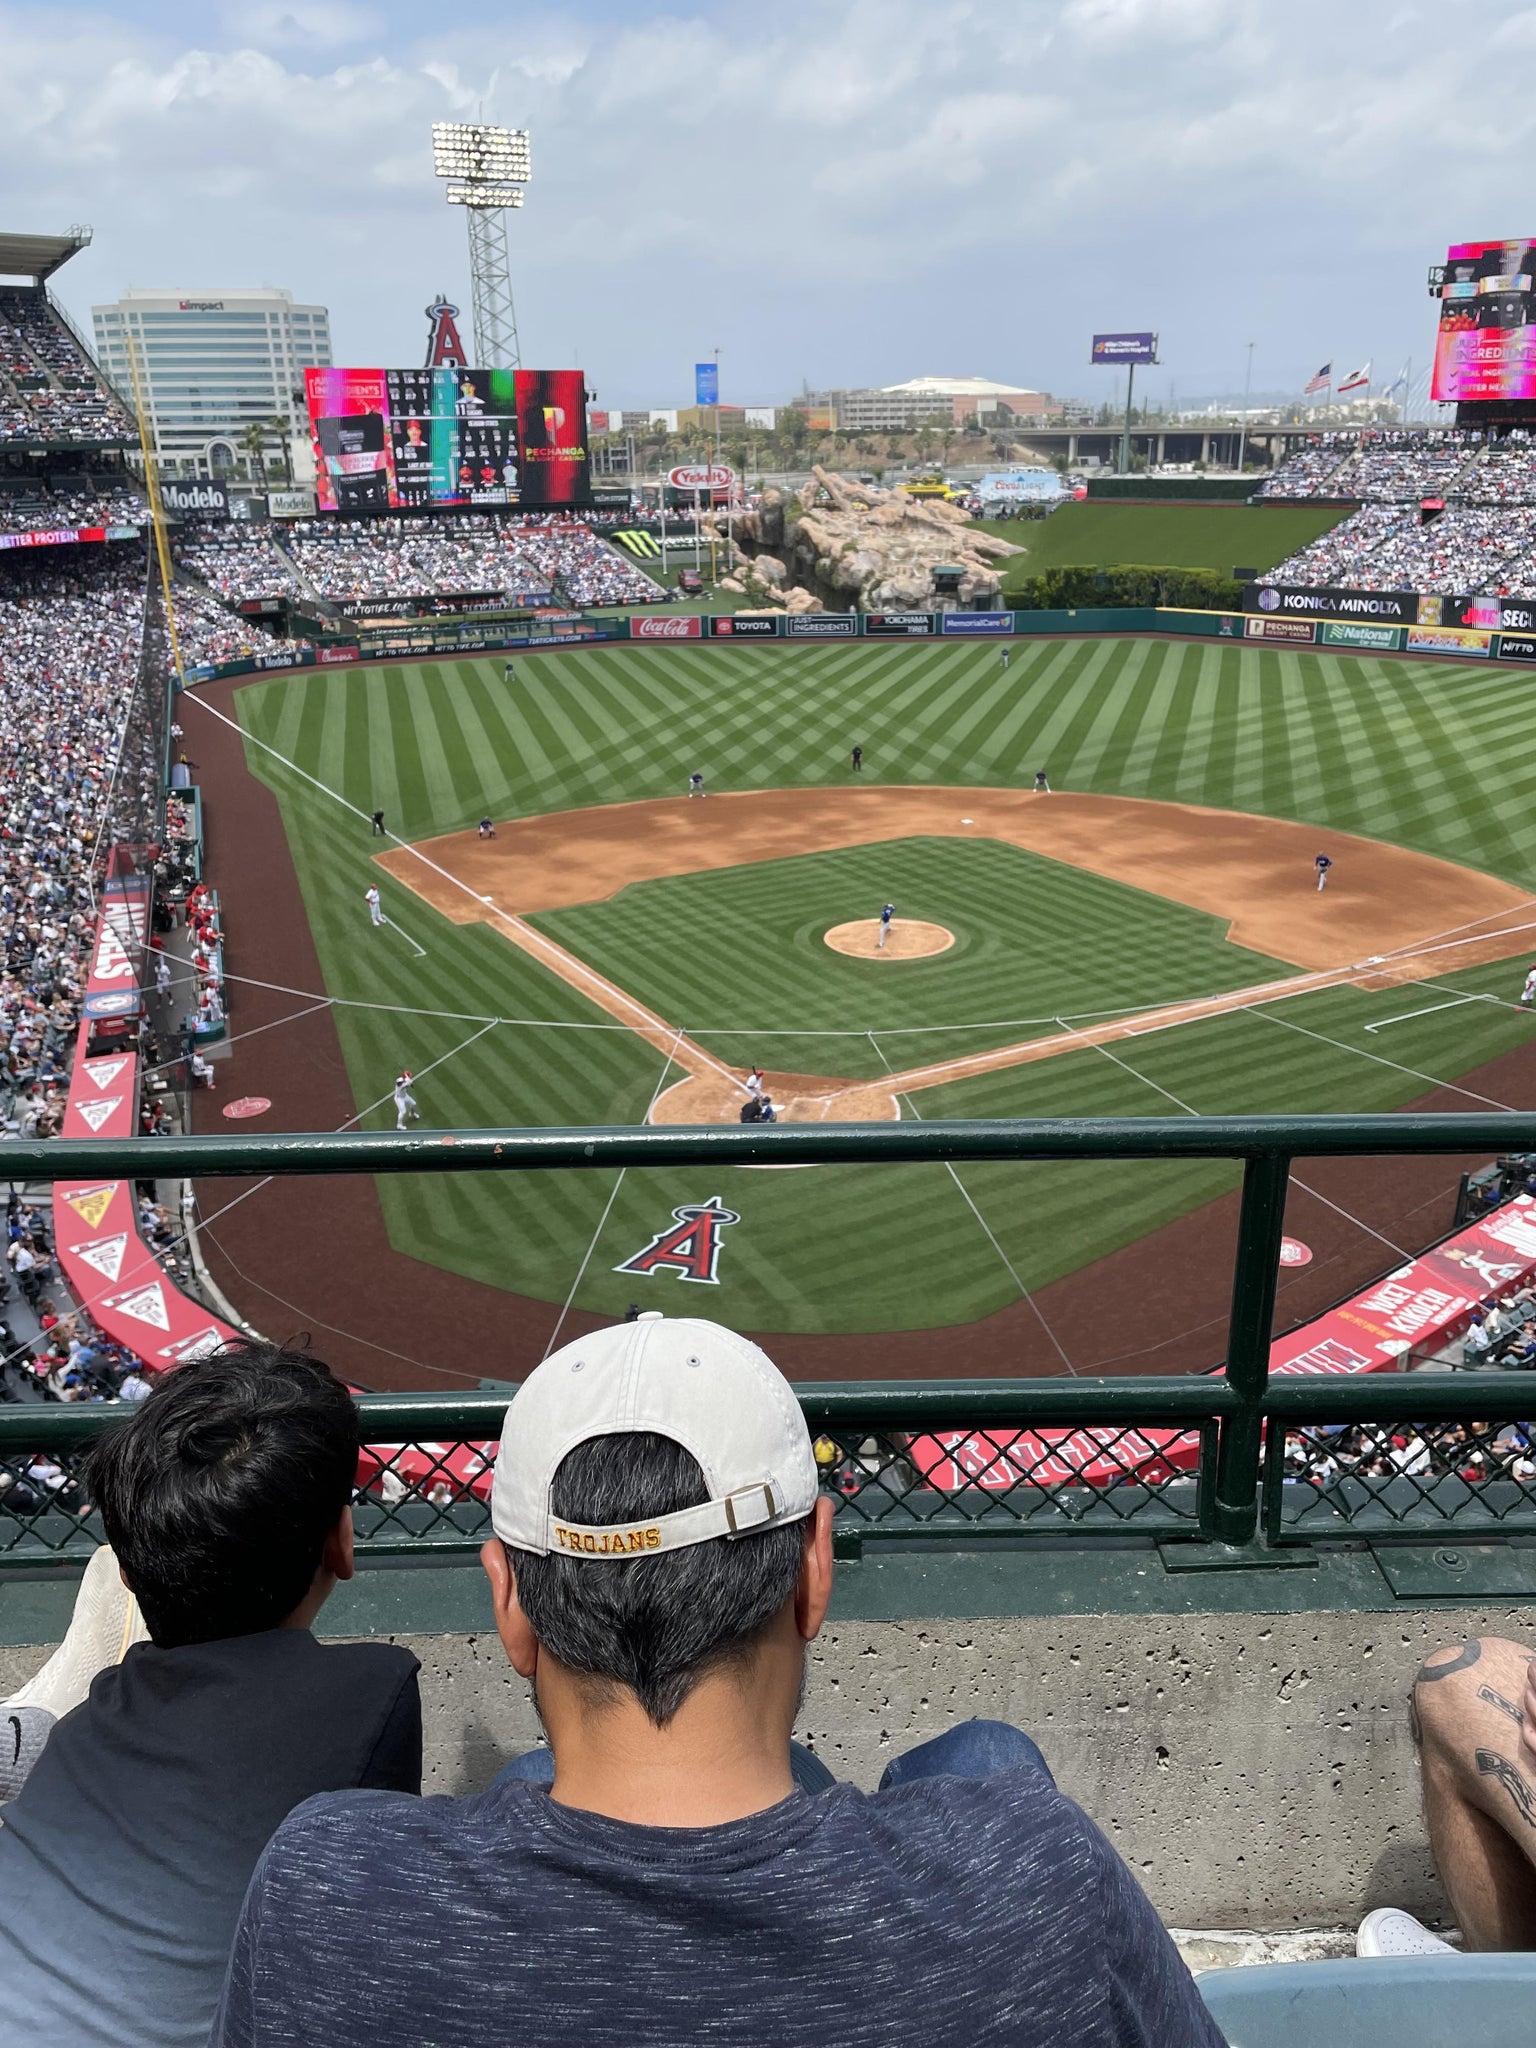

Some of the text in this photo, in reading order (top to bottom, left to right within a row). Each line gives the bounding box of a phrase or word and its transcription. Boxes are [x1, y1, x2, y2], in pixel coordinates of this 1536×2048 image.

[526, 447, 584, 456] PECHANGA
[161, 485, 225, 509] Modelo
[274, 496, 311, 510] Modelo
[34, 530, 79, 544] PROTEIN
[1284, 595, 1402, 615] KONICA MINOLTA
[734, 622, 772, 630] TOYOTA
[793, 616, 812, 624] JUST
[883, 616, 929, 624] YOKOHAMA
[946, 619, 1000, 628] MemorialCare
[793, 623, 850, 632] INGREDIENTS
[907, 625, 929, 633] TIRES
[1266, 622, 1311, 633] PECHANGA
[1344, 626, 1393, 640] National
[1503, 641, 1535, 653] NITTO
[264, 655, 292, 669] Modelo
[94, 902, 146, 980] ANGELS
[555, 1526, 662, 1554] TROJANS
